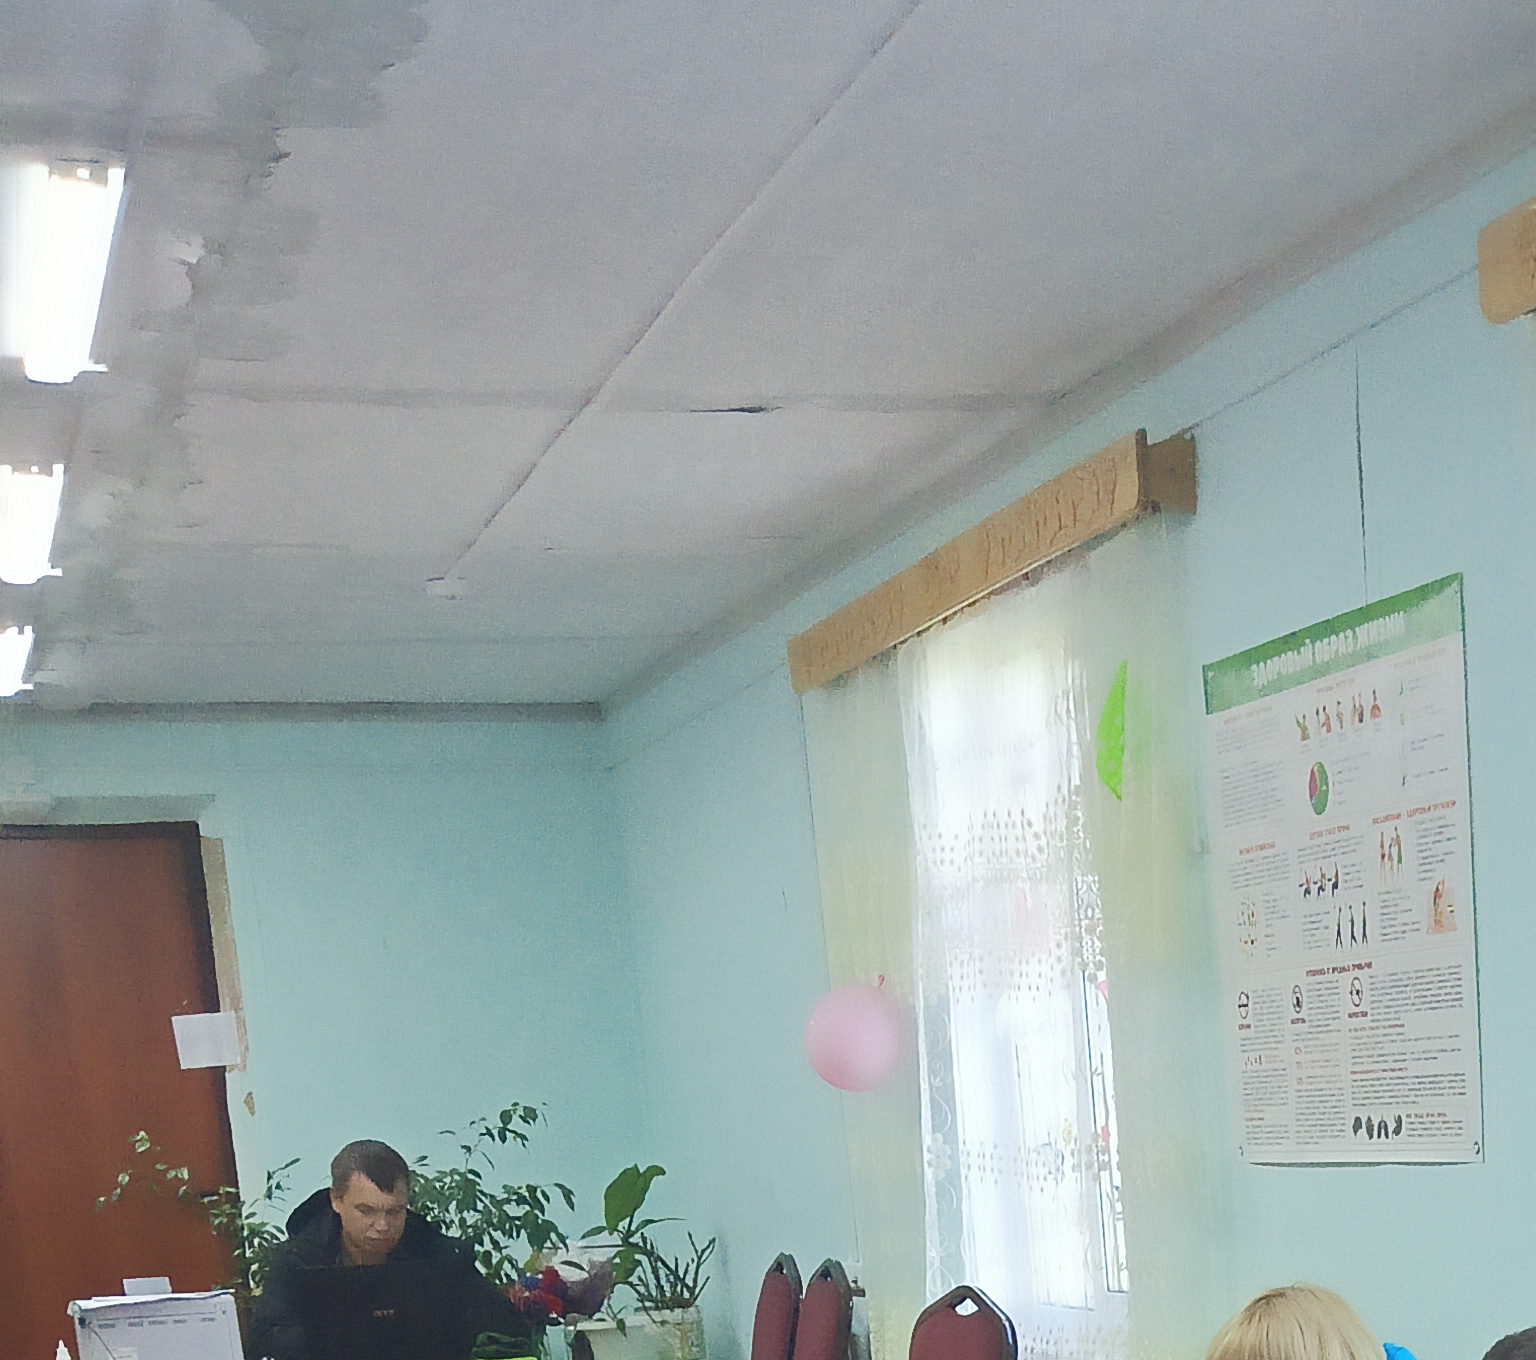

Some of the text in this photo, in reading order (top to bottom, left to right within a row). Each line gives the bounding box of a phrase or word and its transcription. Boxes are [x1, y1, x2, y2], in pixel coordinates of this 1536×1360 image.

[1251, 639, 1313, 688] ЗДОРОВЫЙ
[1315, 629, 1353, 664] ОБРАЗ
[1355, 611, 1405, 650] ЖИЗНИ
